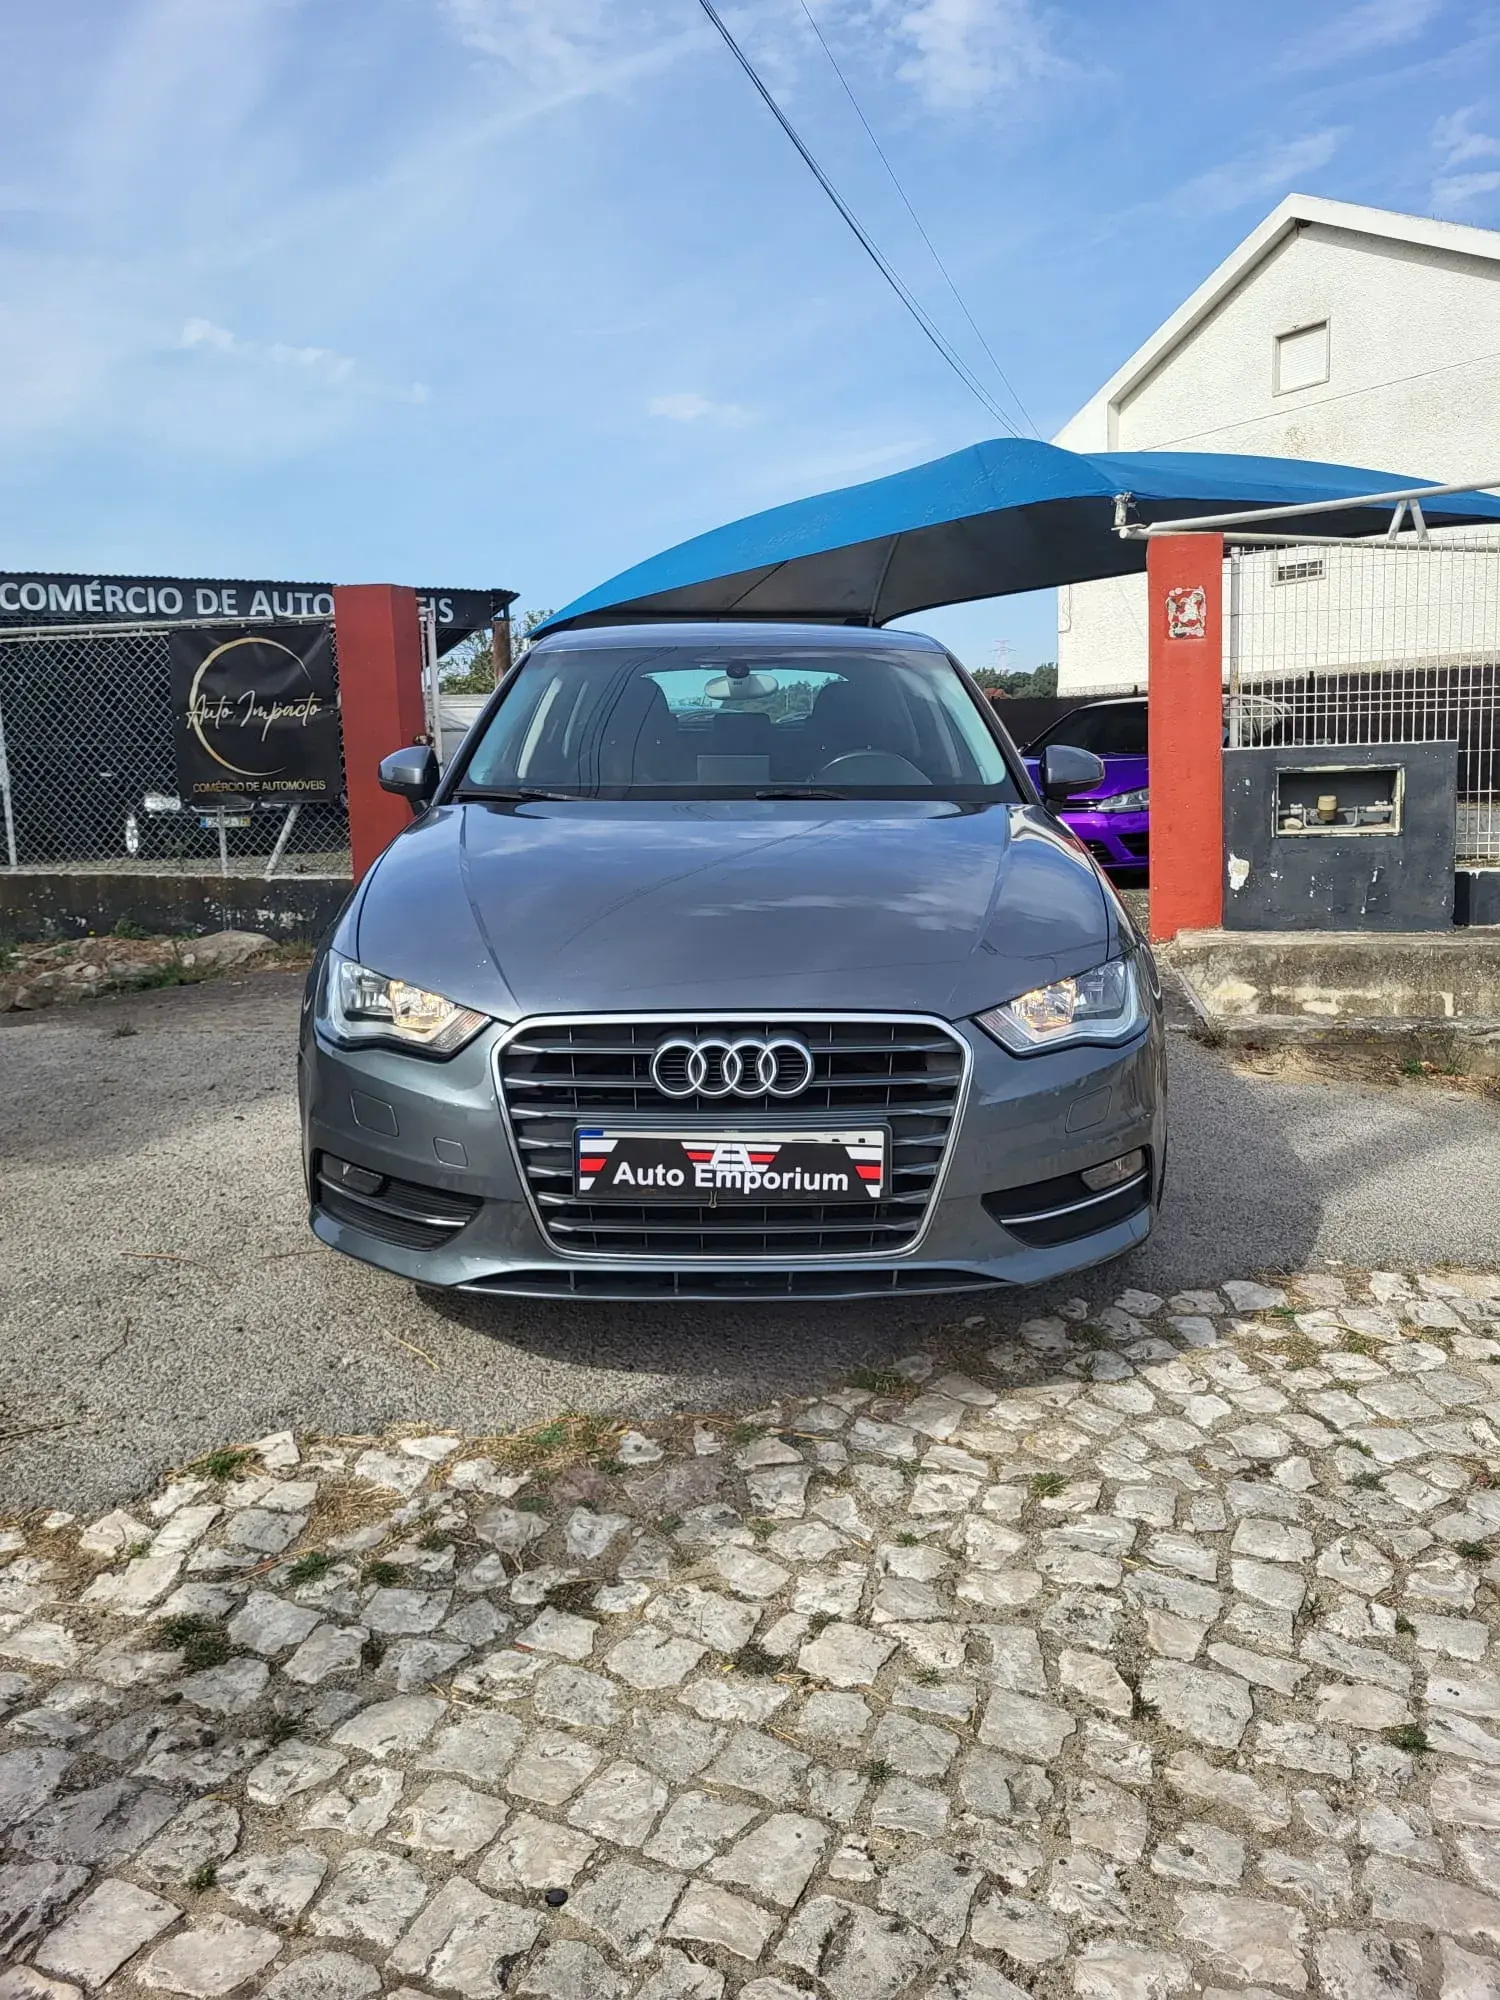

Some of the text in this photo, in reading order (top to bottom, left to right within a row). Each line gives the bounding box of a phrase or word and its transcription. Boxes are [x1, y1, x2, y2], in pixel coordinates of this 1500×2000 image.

[0, 579, 183, 615] COMÉRCIO
[196, 588, 238, 615] DE
[185, 690, 323, 742] Auto Impacto
[193, 778, 326, 793] COMÉRCIO DE AUTOMÓVEIS
[612, 1162, 848, 1194] Auto Emporium
